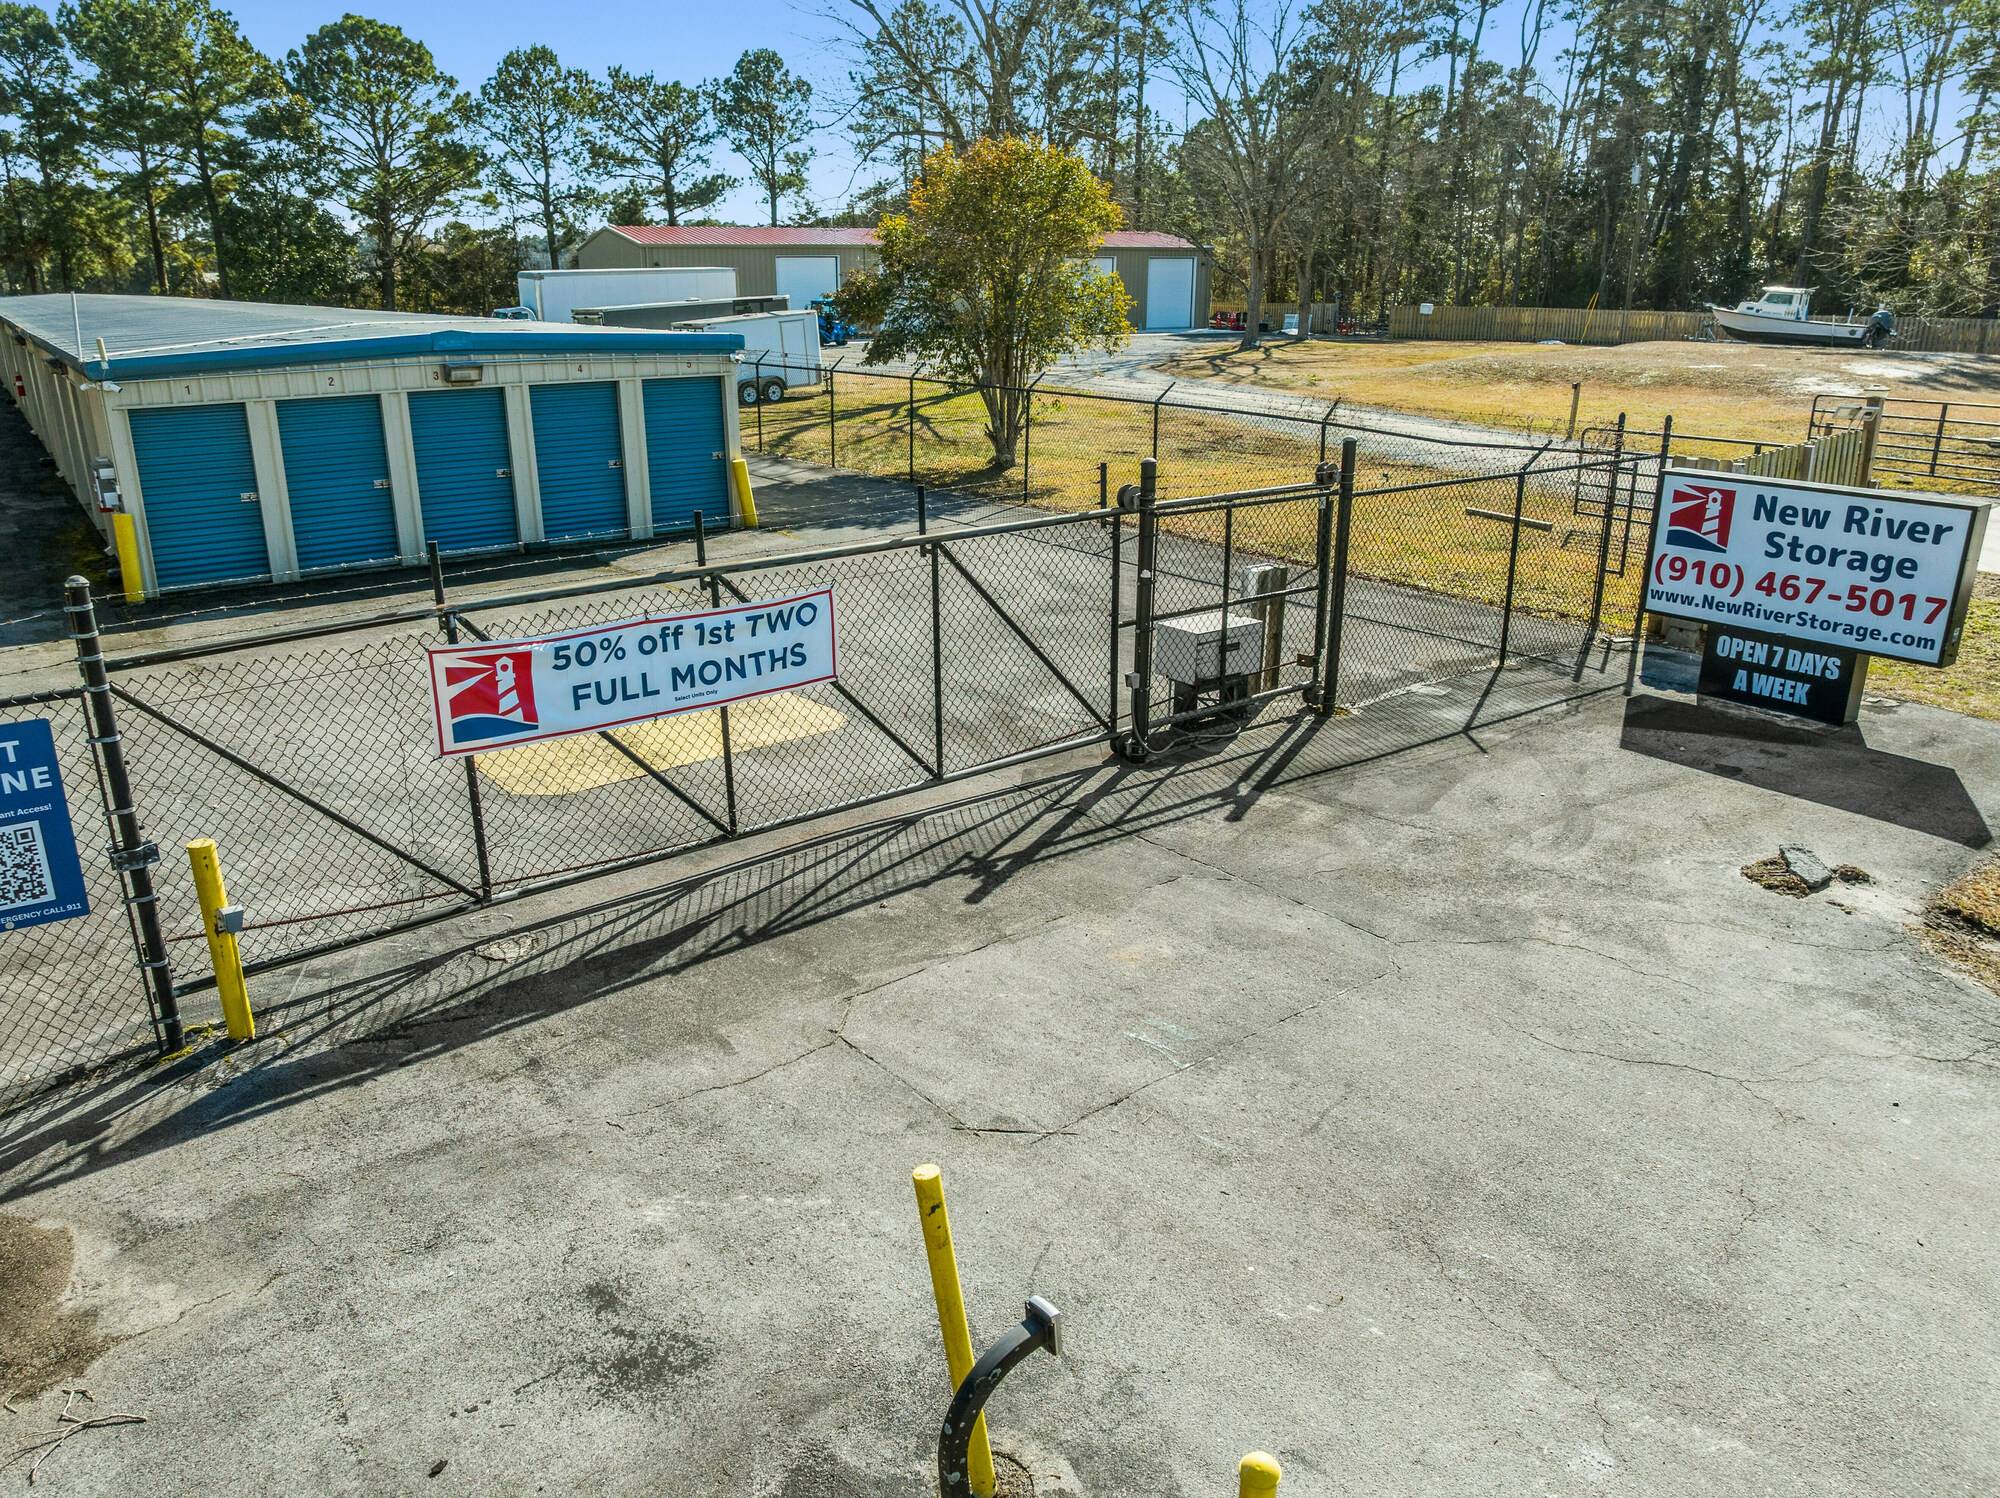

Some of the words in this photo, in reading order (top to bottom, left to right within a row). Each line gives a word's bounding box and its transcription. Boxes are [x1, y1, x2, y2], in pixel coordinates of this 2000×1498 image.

[328, 376, 335, 387] 2
[433, 371, 439, 381] 3
[577, 364, 583, 374] 4
[185, 384, 191, 395] 1
[1753, 494, 1831, 530] New
[1843, 505, 1954, 545] River
[1764, 532, 1919, 582] Storage
[1654, 553, 1745, 597] (910)
[1755, 572, 1948, 625] 467-5017
[552, 635, 626, 671] 50%
[638, 624, 683, 656] off
[694, 620, 735, 647] 1st
[745, 602, 818, 637] TWO
[1650, 588, 1936, 651] www.NewRiverStorage.com
[1716, 635, 1768, 666] OPEN
[1770, 646, 1783, 668] 7
[1785, 649, 1841, 680] DAYS
[572, 672, 660, 711] FULL
[671, 642, 807, 692] MONTHS
[1732, 669, 1748, 691] A
[1751, 672, 1812, 706] WEEK
[674, 694, 691, 702] Select
[17, 803, 52, 816] Access!
[43, 906, 66, 916] CALL
[66, 902, 82, 910] 911
